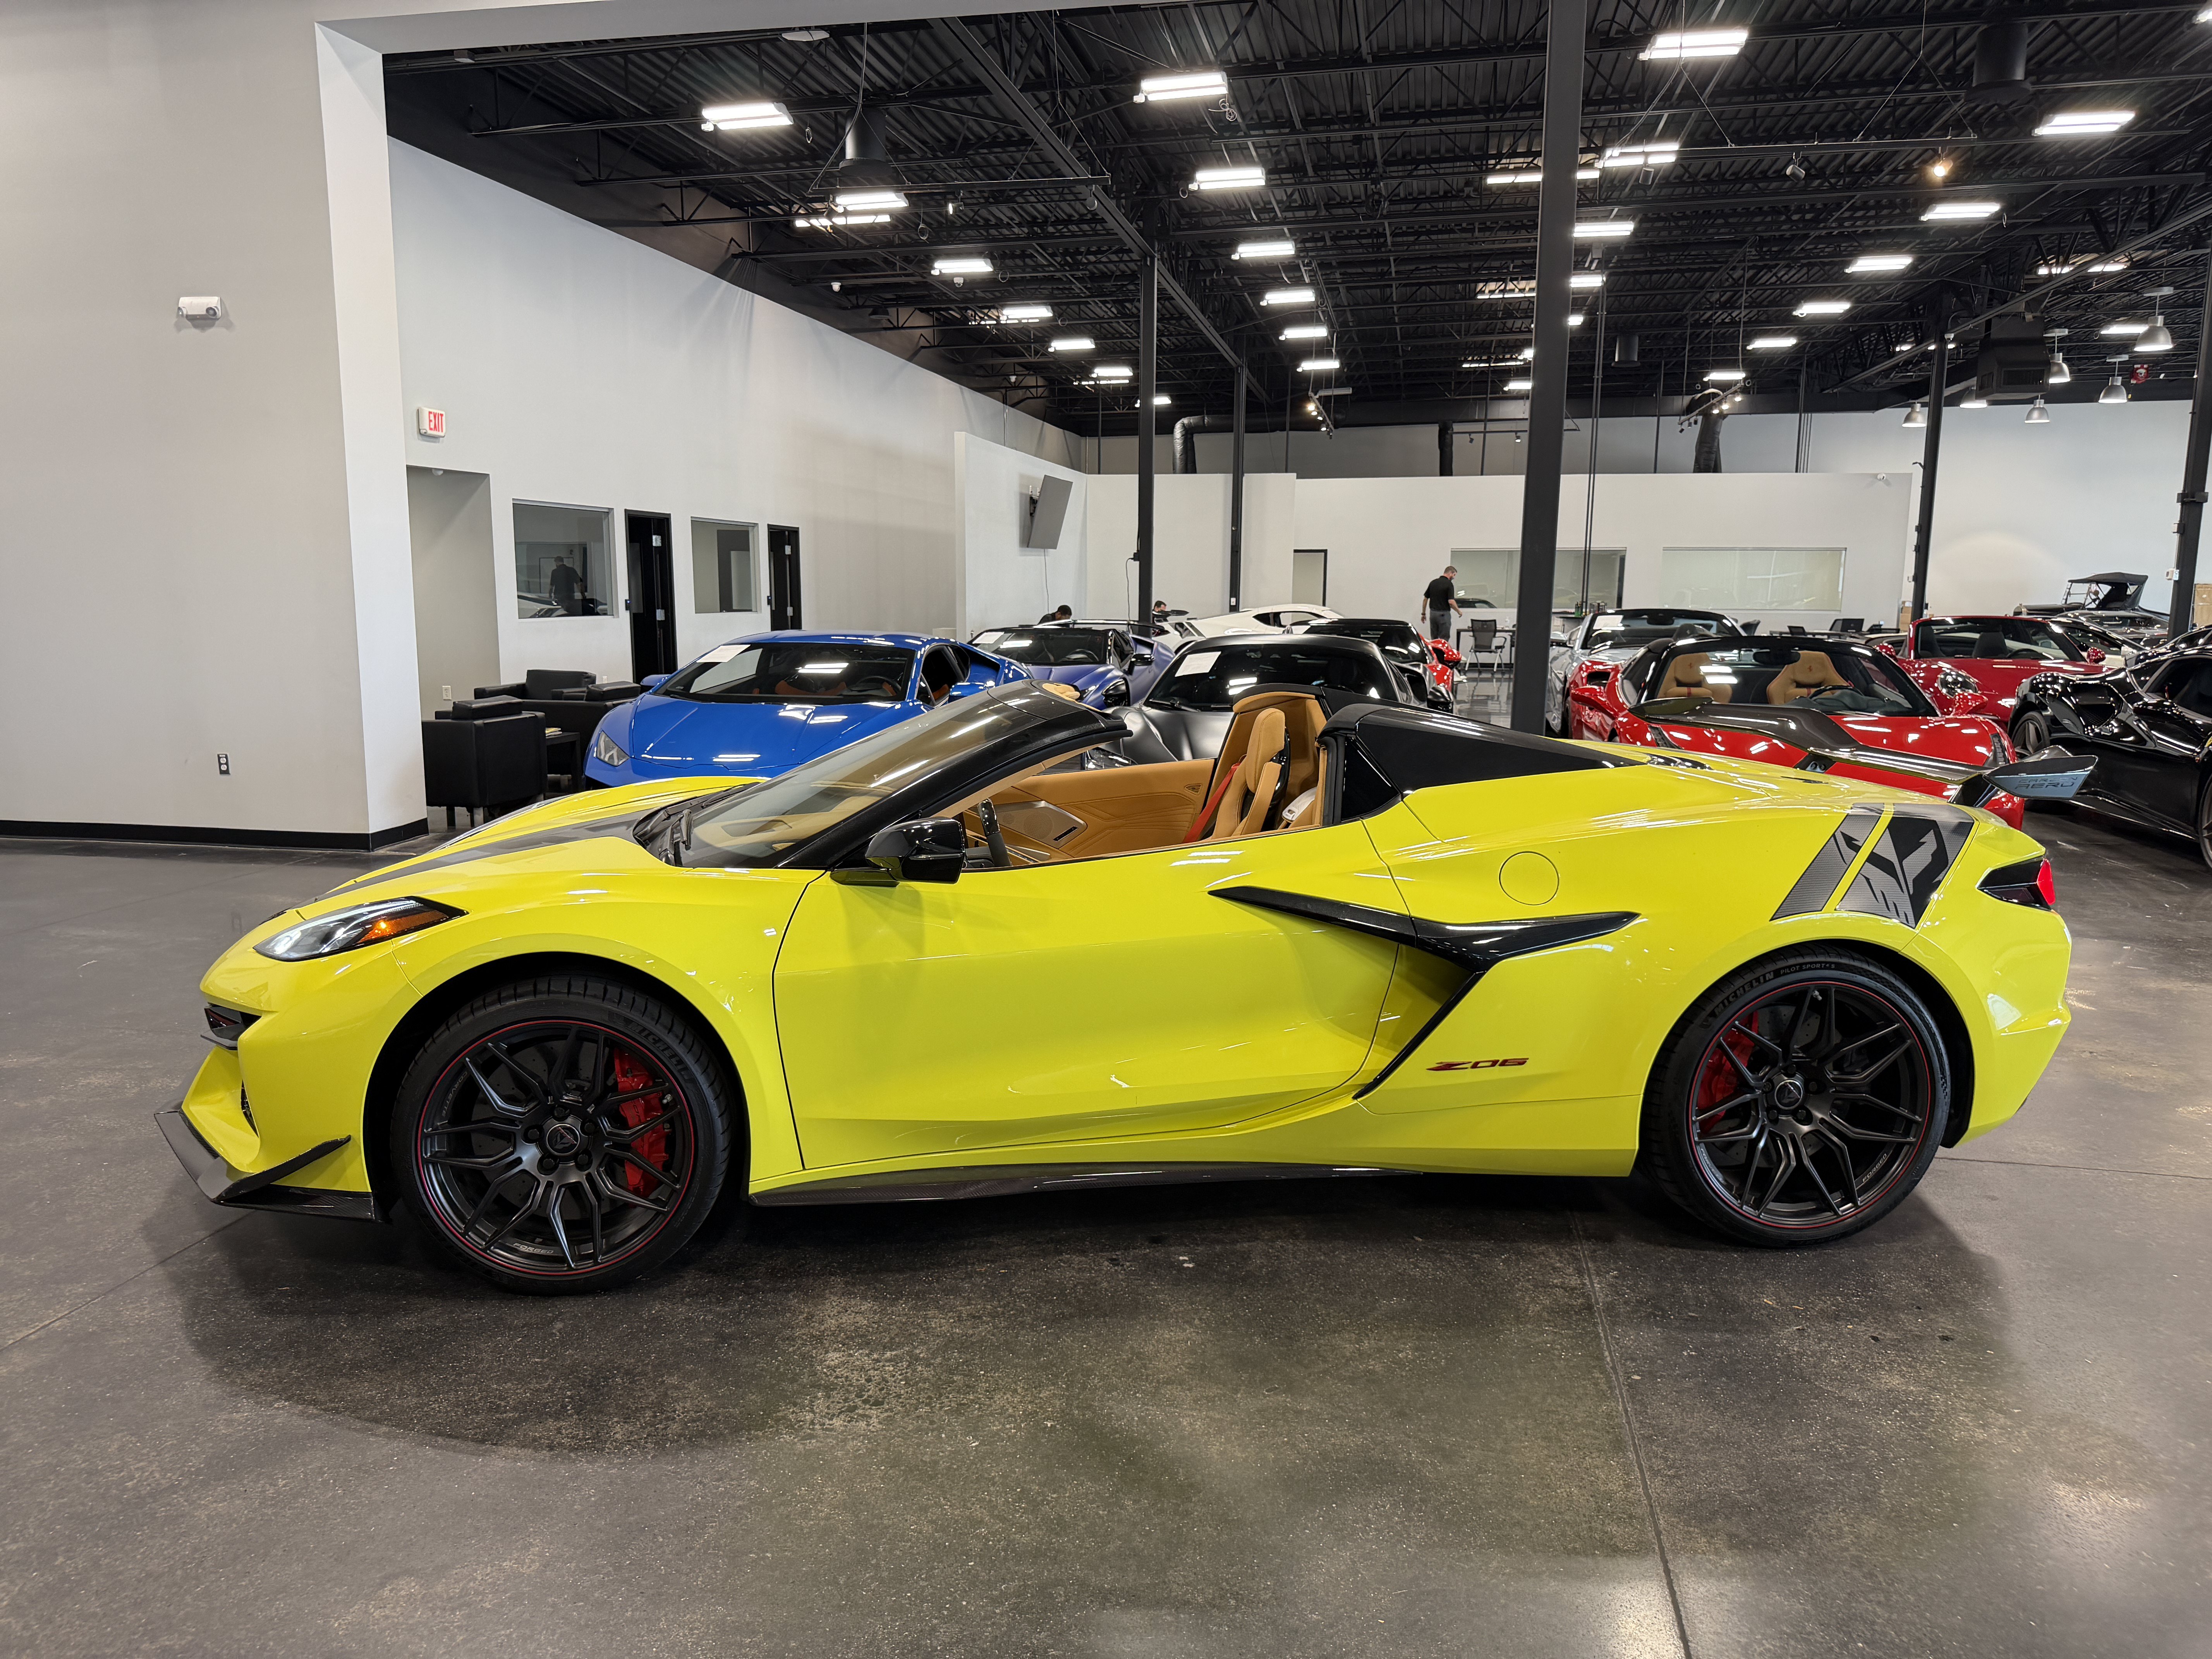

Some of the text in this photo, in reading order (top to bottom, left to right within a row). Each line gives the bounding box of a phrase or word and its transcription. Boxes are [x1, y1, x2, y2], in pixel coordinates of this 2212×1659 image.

[429, 411, 443, 433] EXIT
[1714, 971, 1774, 1015] MICHELIN
[1781, 965, 1800, 975] PILOT
[630, 1021, 694, 1080] MICHELIN
[1425, 1058, 1529, 1071] Z06
[441, 1071, 467, 1118] CORVETTE
[1862, 1153, 1887, 1182] FORGED
[513, 1243, 554, 1254] FORGED
